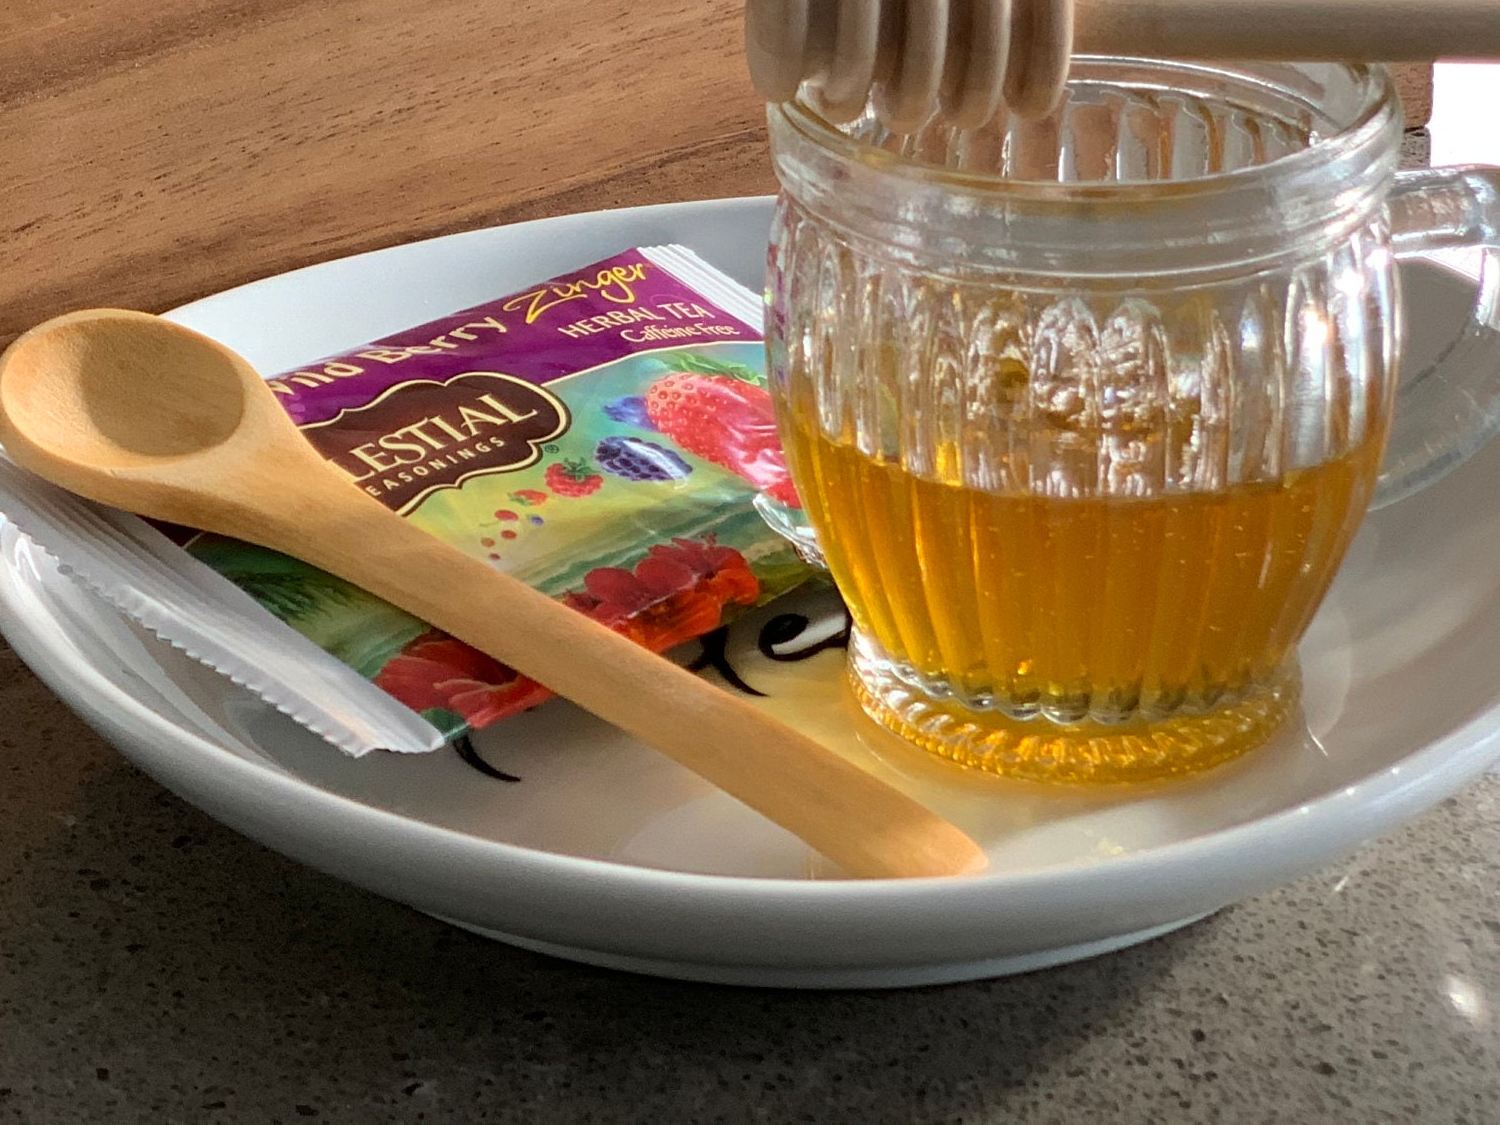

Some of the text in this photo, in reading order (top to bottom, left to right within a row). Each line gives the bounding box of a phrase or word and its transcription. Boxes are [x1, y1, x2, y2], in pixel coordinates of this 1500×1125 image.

[355, 316, 507, 364] Berry
[502, 263, 646, 324] Zinger
[557, 302, 715, 338] HERBAL TEA
[620, 322, 740, 343] Caffeine Free
[365, 436, 505, 497] EASONINGS
